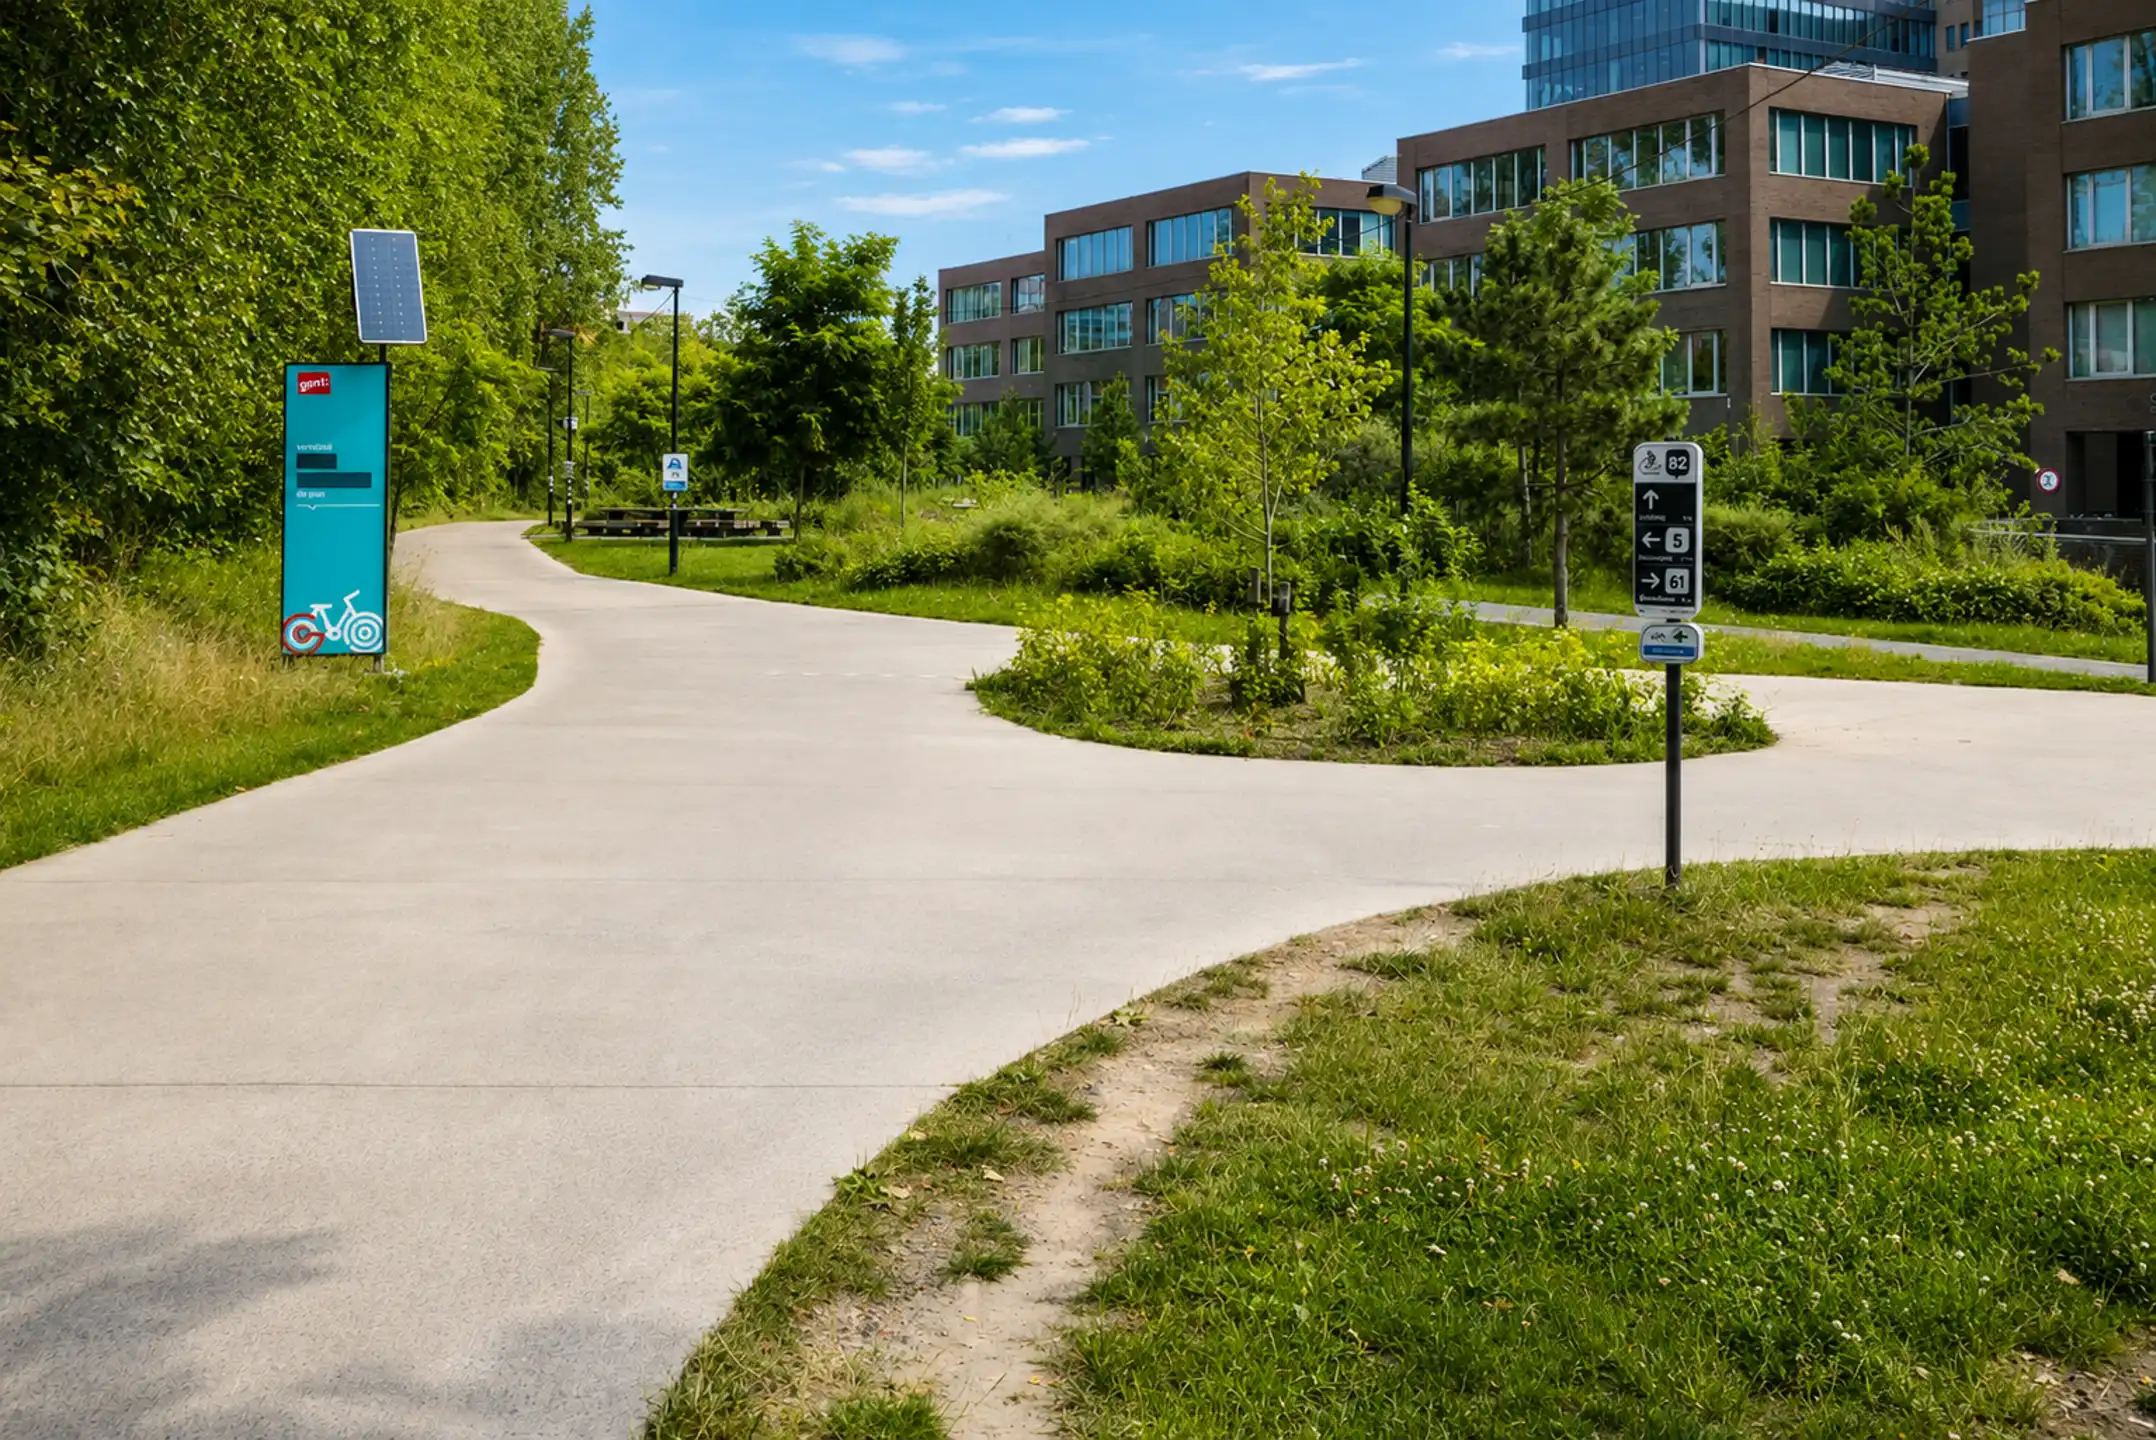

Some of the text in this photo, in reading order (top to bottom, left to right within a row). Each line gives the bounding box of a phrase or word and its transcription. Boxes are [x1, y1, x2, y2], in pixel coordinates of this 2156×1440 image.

[1668, 456, 1688, 470] 82
[1672, 533, 1683, 548] 5
[1669, 575, 1685, 589] 61
